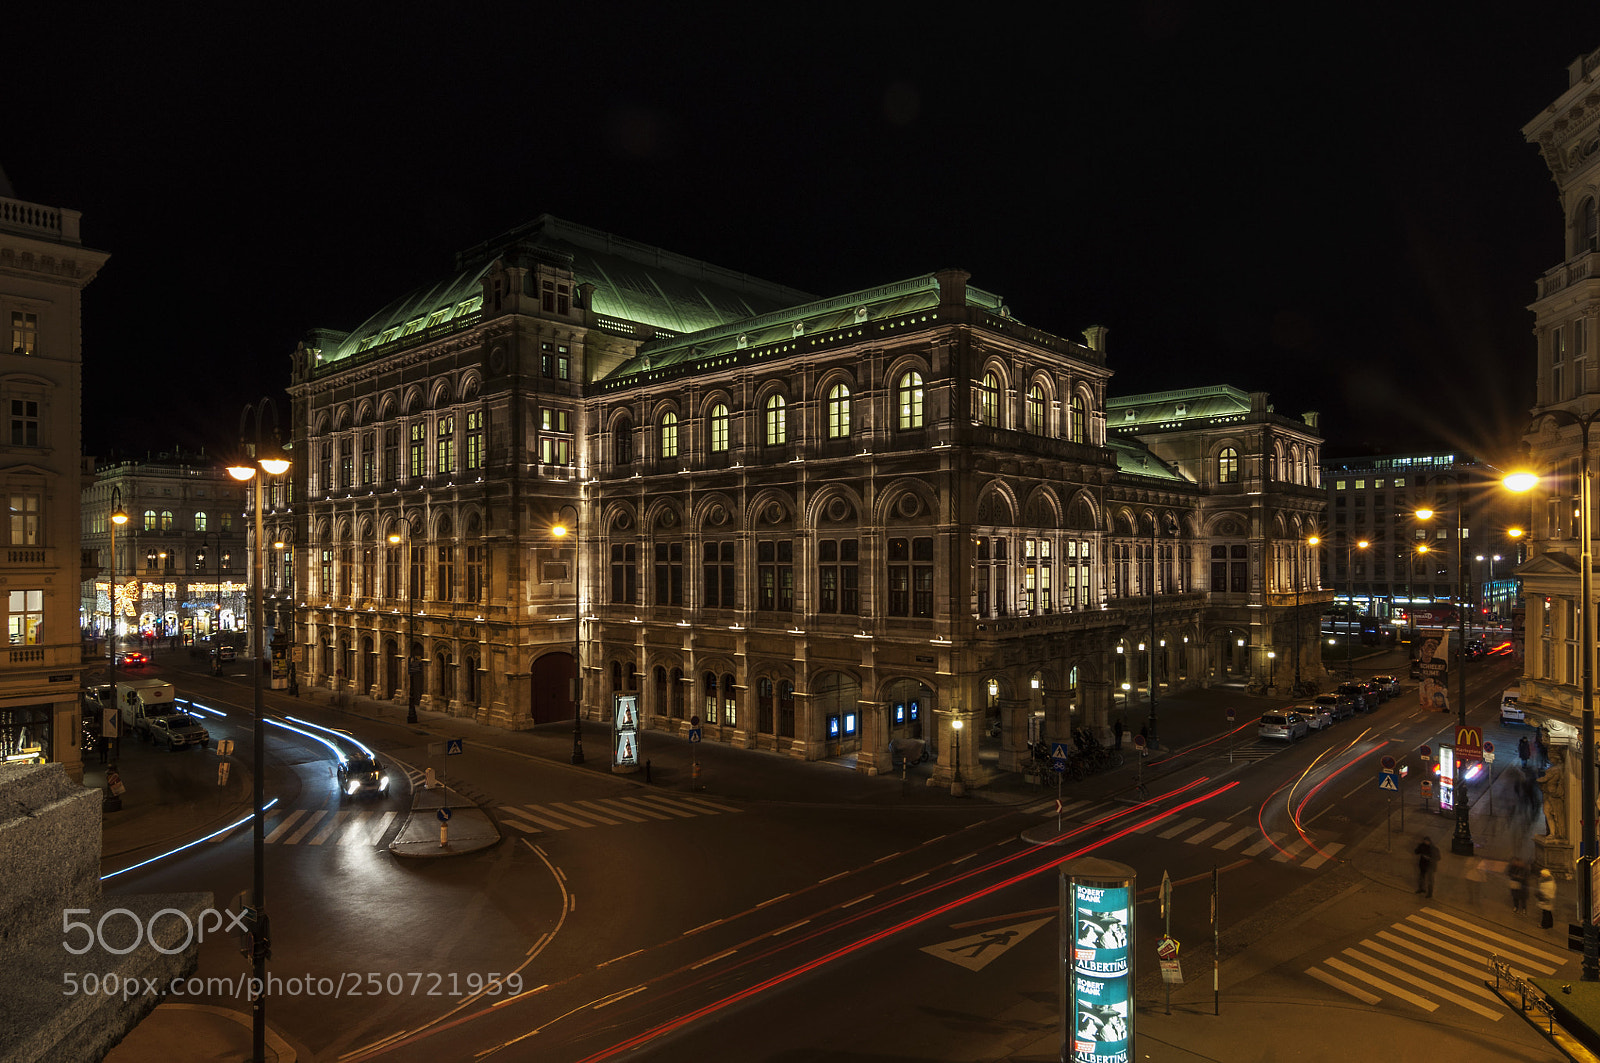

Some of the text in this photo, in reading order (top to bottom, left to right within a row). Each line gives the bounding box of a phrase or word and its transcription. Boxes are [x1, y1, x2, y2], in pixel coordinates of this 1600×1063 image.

[1077, 886, 1105, 897] ROBERT
[1077, 893, 1101, 903] FRANK
[1077, 960, 1127, 972] ALBERTINA
[1077, 977, 1104, 990] ROBERT
[1077, 985, 1101, 996] FRANK
[1077, 1051, 1127, 1063] ALBERTINA
